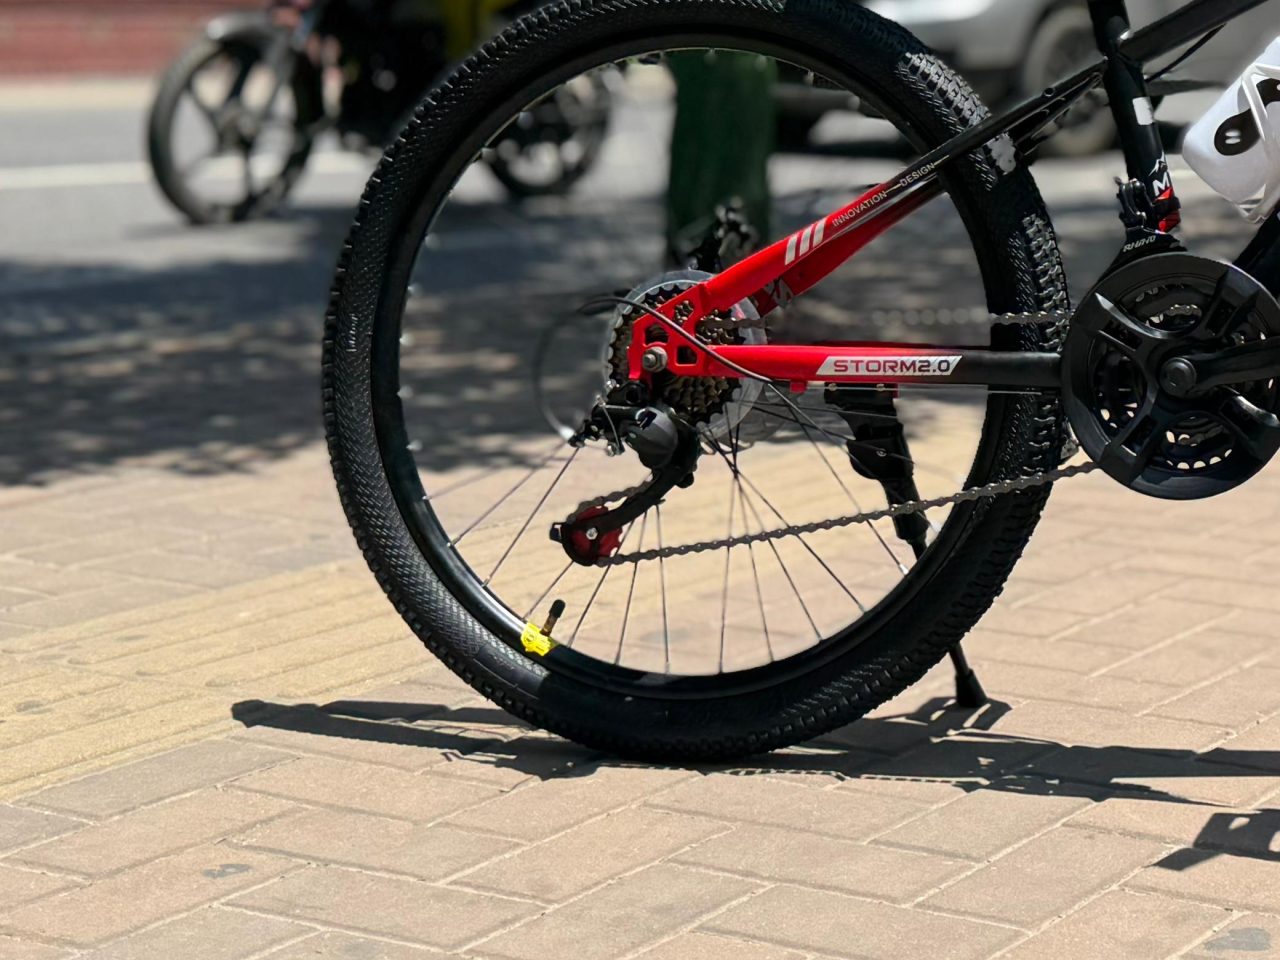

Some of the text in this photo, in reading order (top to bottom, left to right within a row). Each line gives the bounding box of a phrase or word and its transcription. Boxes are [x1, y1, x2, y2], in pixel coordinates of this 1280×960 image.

[832, 162, 935, 227] INNOVATION DESIGN
[833, 359, 951, 373] STORM2.0
